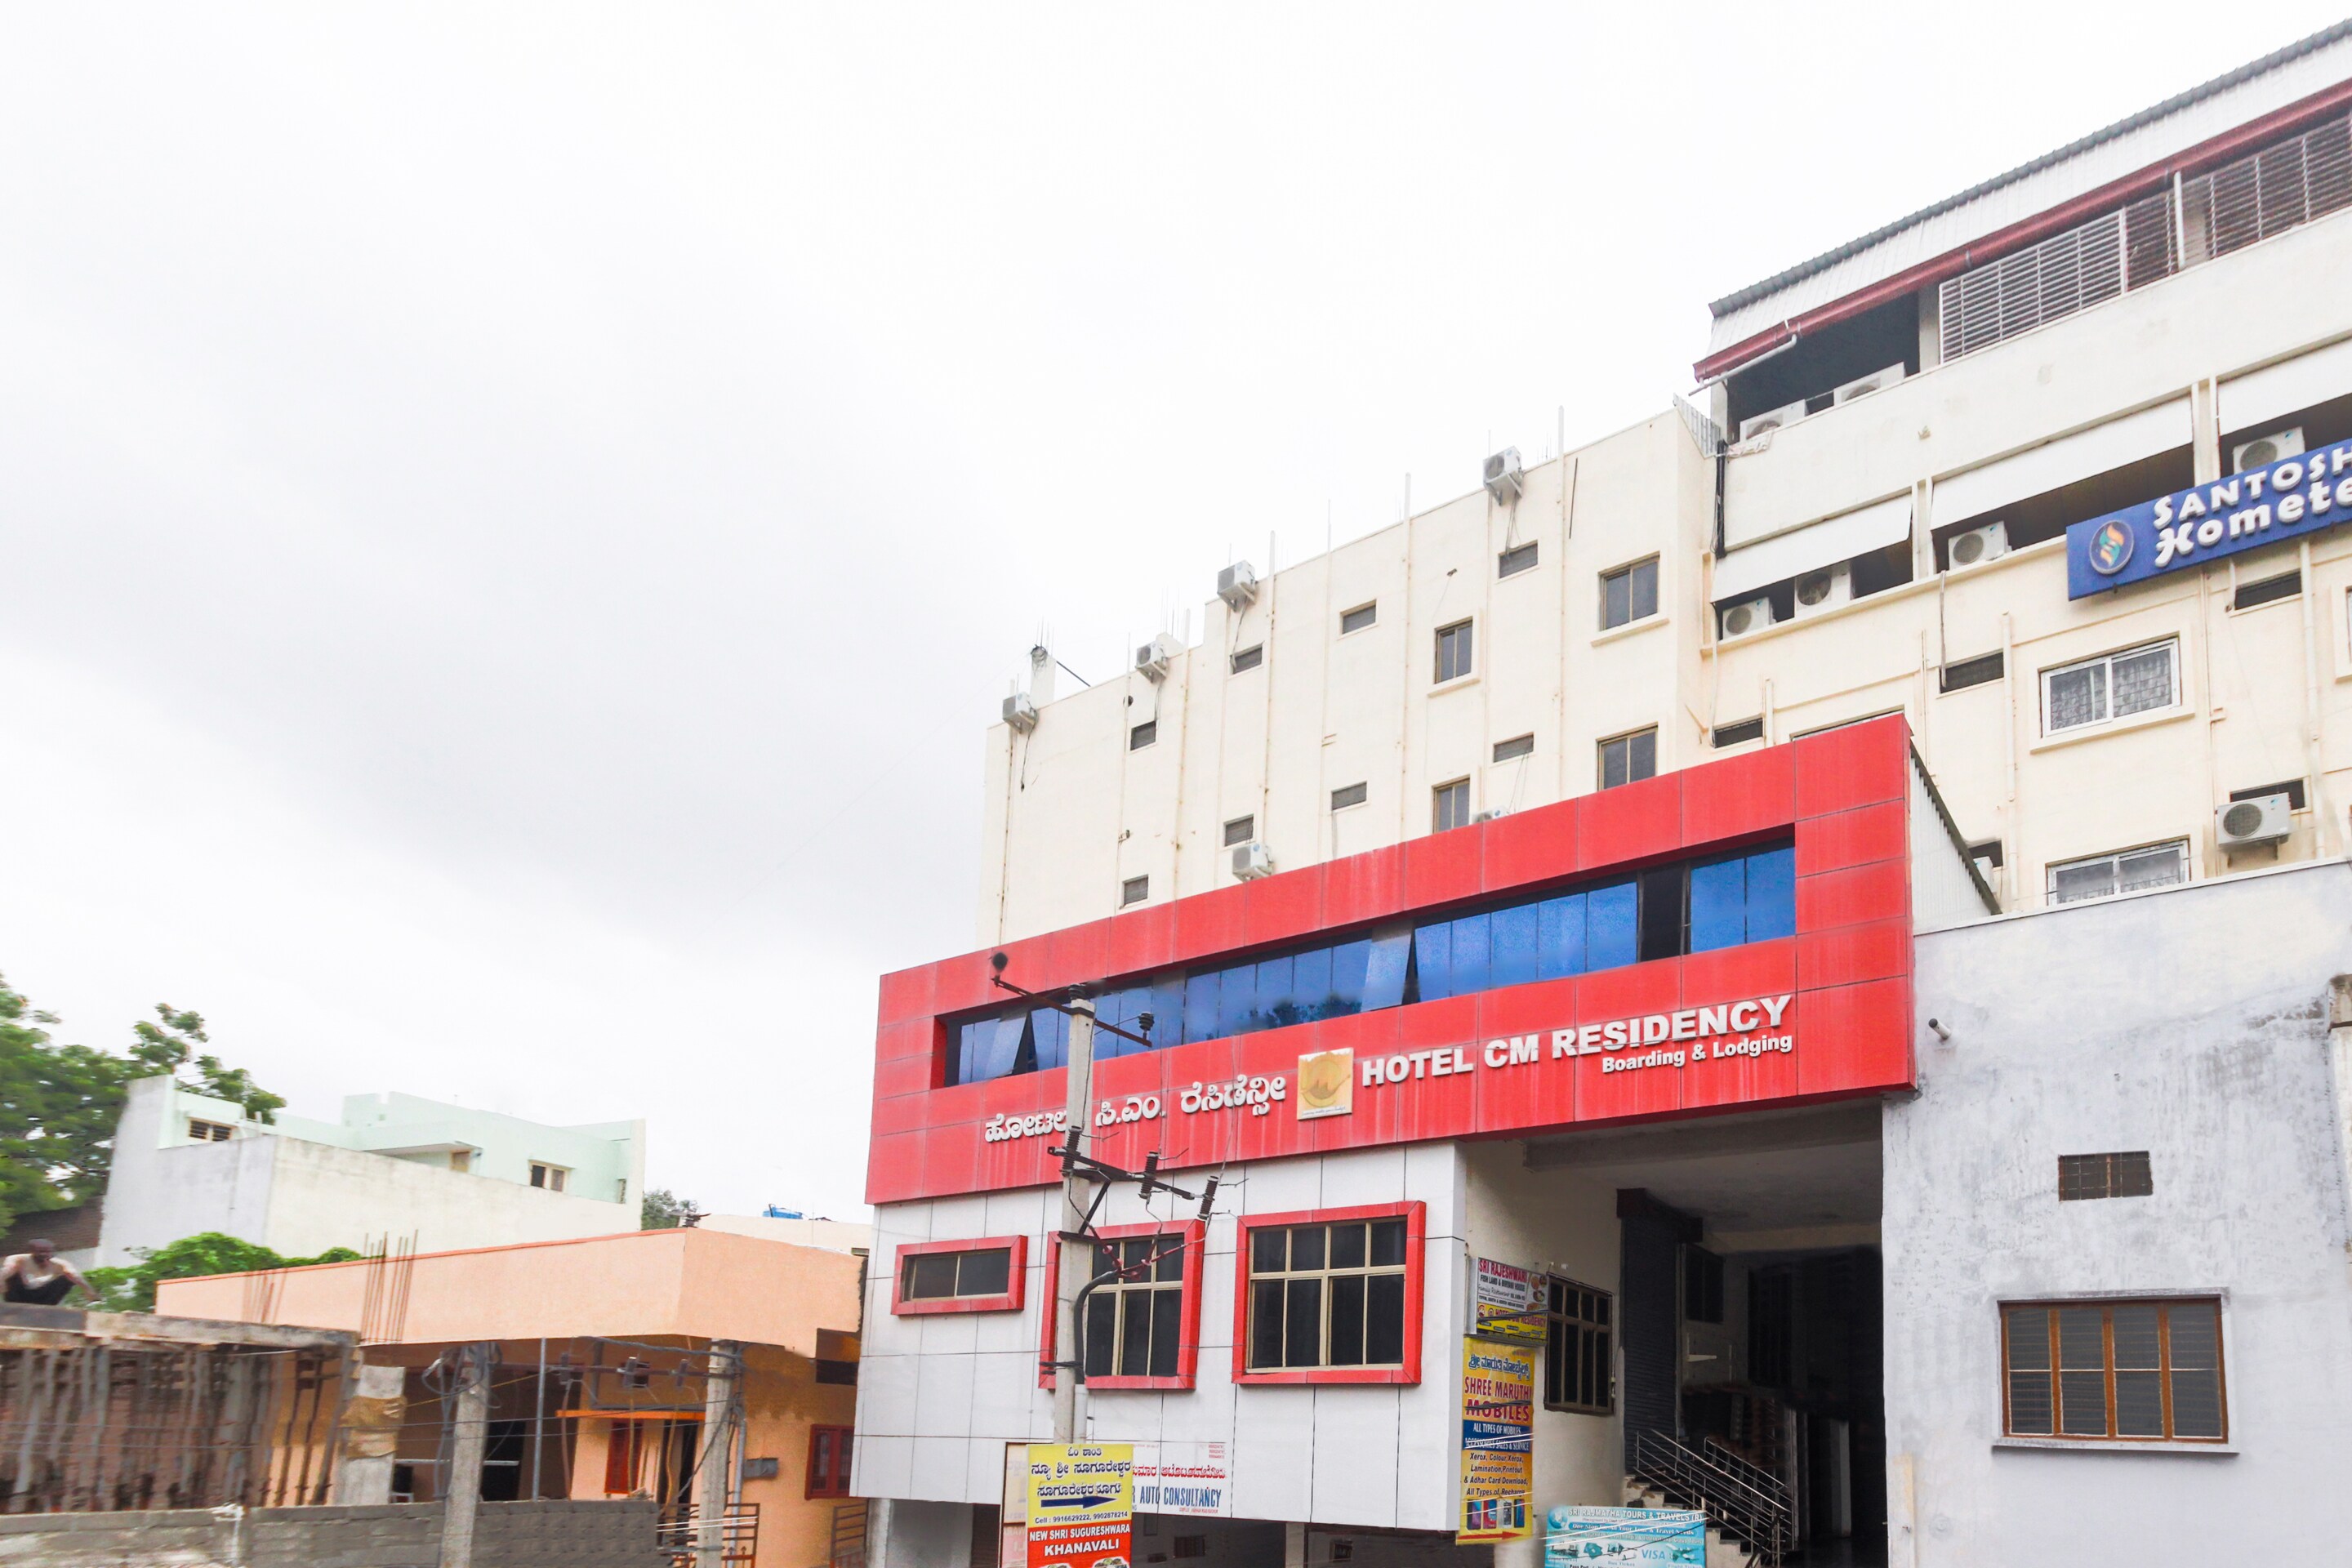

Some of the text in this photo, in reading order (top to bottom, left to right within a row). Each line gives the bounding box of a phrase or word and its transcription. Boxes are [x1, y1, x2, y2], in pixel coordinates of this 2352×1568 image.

[2153, 446, 2352, 530] SANTOSH
[1361, 994, 1792, 1087] HOTEL CM RESIDENCY
[1601, 1034, 1793, 1074] Boarding & Lodging
[984, 1112, 1067, 1143] ಹೋಟಲ
[1479, 1259, 1490, 1273] SRI
[1464, 1376, 1532, 1400] SHREE MARUTHI
[1466, 1398, 1530, 1421] MOBILES
[1473, 1423, 1481, 1432] ALL
[1482, 1423, 1495, 1433] TYPES
[1496, 1424, 1503, 1434] OF
[1067, 1446, 1079, 1457] ಓಂ
[1031, 1463, 1051, 1481] ನ್ಯೂ
[1056, 1461, 1069, 1478] ಶ್ರೀ
[1470, 1476, 1486, 1484] Adhar
[1140, 1486, 1160, 1504] AUTO
[1164, 1486, 1222, 1508] CONSULTANCY
[1477, 1488, 1492, 1497] Types
[1494, 1487, 1499, 1495] of
[1093, 1512, 1128, 1521] 9902878214
[1569, 1508, 1579, 1517] SRI
[1582, 1508, 1621, 1517] RAJMATHA
[1622, 1510, 1646, 1519] TOURS
[1656, 1512, 1690, 1521] TRAVELS
[1030, 1530, 1048, 1542] NEW
[1049, 1529, 1068, 1540] SHRI
[1070, 1524, 1130, 1538] SUGURESHWARA
[1045, 1539, 1120, 1557] KHANAVALI
[1642, 1548, 1666, 1560] VISA
